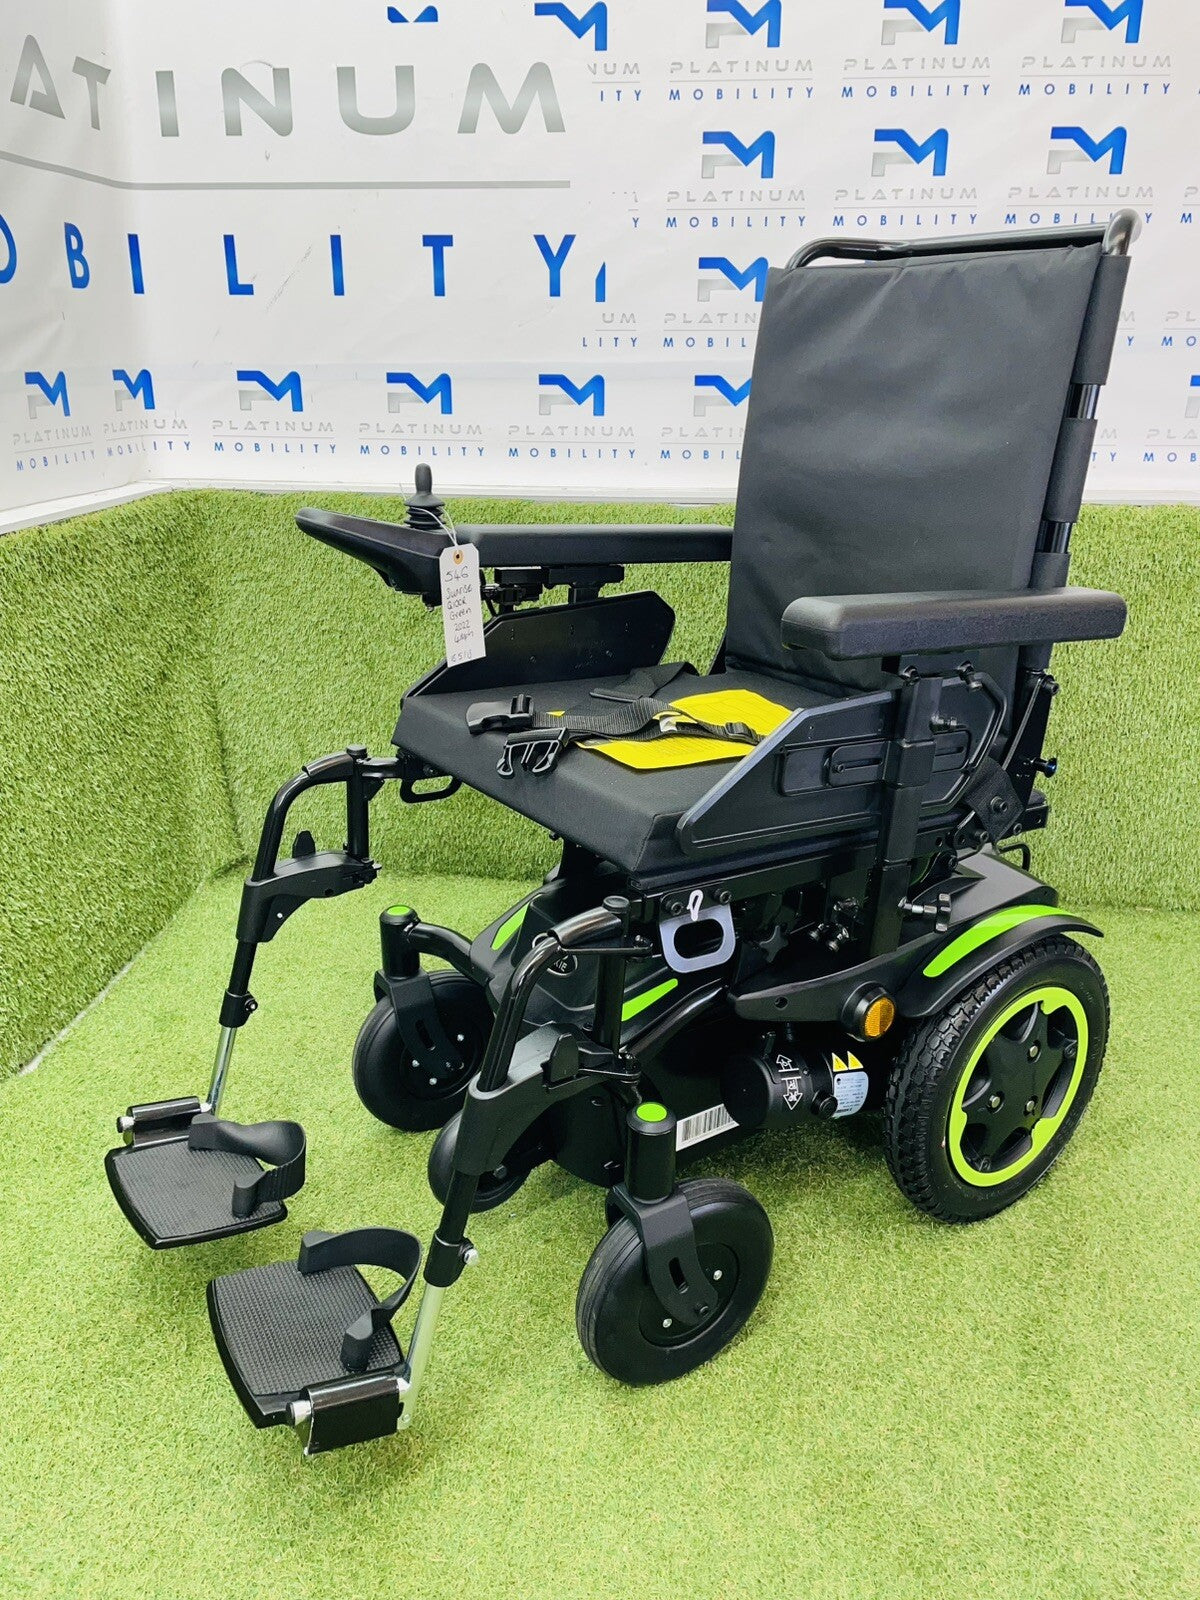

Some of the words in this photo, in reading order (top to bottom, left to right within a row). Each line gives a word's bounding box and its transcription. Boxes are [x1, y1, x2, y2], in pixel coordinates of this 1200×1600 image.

[669, 59, 814, 74] PLATINUM
[843, 57, 991, 71] PLATINUM
[1021, 55, 1172, 68] PLATINUM
[9, 34, 567, 137] ATINUM
[841, 84, 991, 97] MOBILITY
[1018, 82, 1171, 95] MOBILITY
[668, 87, 814, 101] MOBILITY
[666, 189, 806, 202] PLATINUM
[834, 187, 978, 201] PLATINUM
[1007, 185, 1154, 199] PLATINUM
[665, 215, 806, 228] MOBILITY
[832, 213, 978, 227] MOBILITY
[1004, 212, 1153, 225] MOBILY
[663, 312, 758, 324] PLATIN
[662, 336, 747, 348] MOBIL
[103, 418, 189, 434] PLATINUM
[211, 419, 335, 432] PLATINUM
[358, 422, 484, 435] PLATINUM
[507, 424, 635, 437] PLATINUM
[660, 426, 747, 438] PLATI
[12, 425, 92, 446] PLATINUM
[106, 441, 192, 457] MOBILITY
[213, 441, 337, 454] MOBILITY
[360, 444, 485, 457] MOBILITY
[507, 447, 636, 459] MOBILITY
[16, 450, 96, 471] MOBILITY
[660, 449, 741, 460] MOBIL
[444, 566, 469, 583] 546
